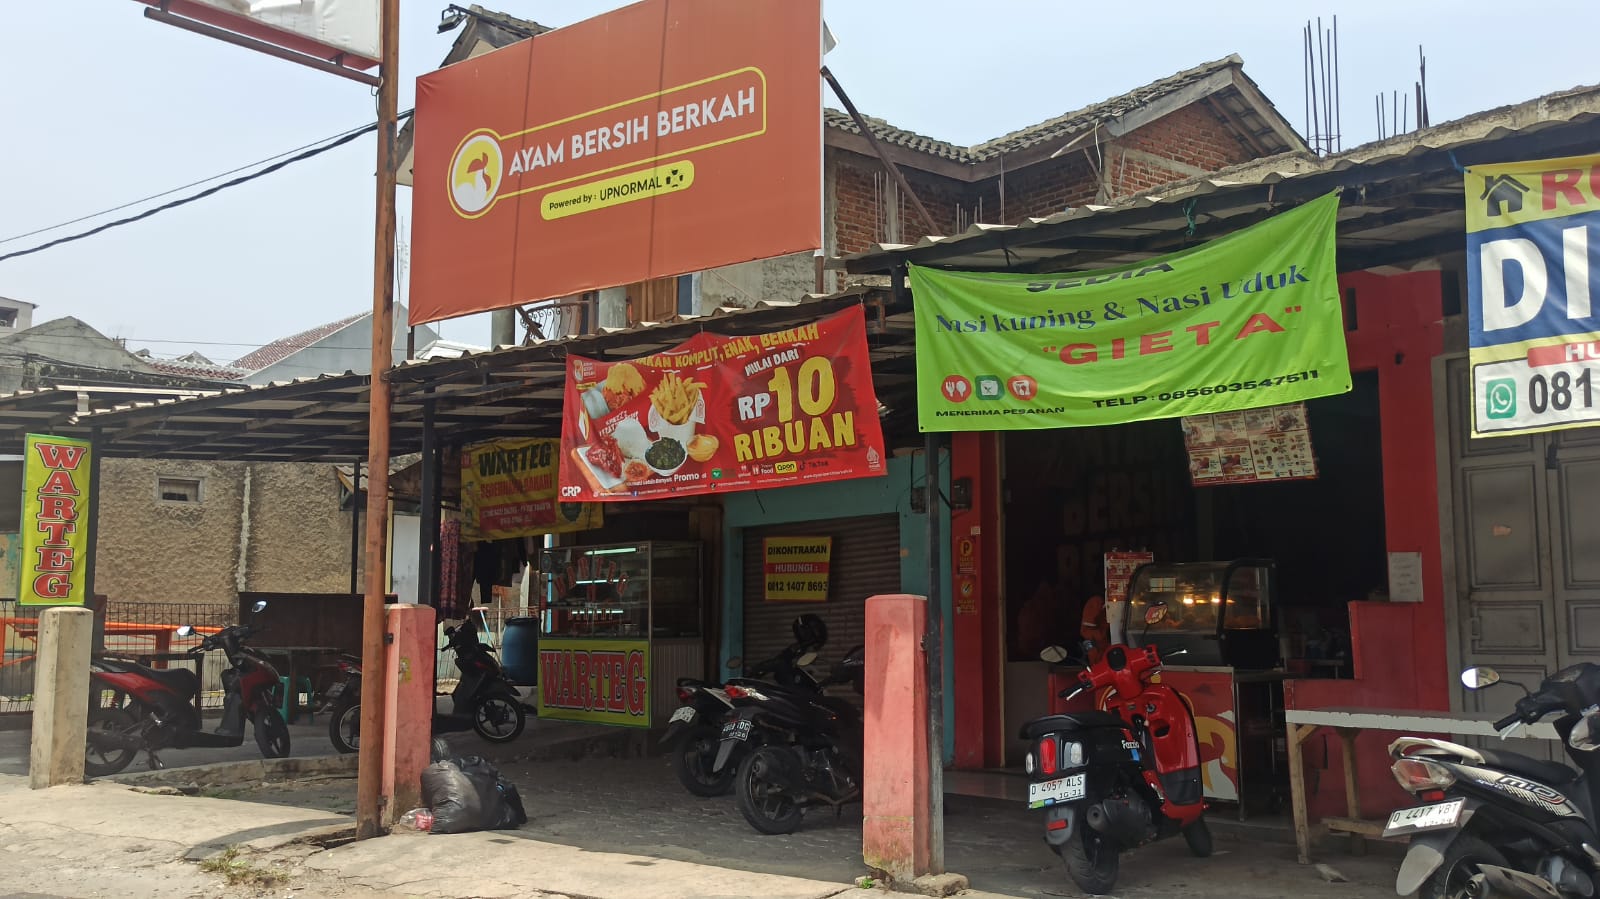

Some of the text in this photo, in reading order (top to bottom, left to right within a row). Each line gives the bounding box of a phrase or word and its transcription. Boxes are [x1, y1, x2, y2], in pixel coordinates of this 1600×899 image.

[508, 86, 756, 177] AYAM BERSIH BERKAH
[549, 194, 582, 211] Powered
[583, 193, 593, 204] by
[599, 175, 663, 202] UPNORMAL
[1540, 166, 1600, 212] R
[1102, 301, 1127, 322] &
[1137, 285, 1212, 316] Nasi
[1220, 263, 1310, 301] Uduk
[744, 348, 800, 377] MULAI DARI
[737, 355, 836, 424] RP 10
[1092, 393, 1148, 409] TELP
[1528, 366, 1593, 415] 081
[935, 406, 1065, 418] MENERIMA PESANAN
[733, 410, 856, 463] RIBUAN
[478, 441, 552, 477] WARTEG
[674, 472, 700, 482] Promo
[32, 442, 87, 599] WARTEG
[767, 545, 827, 555] DIKONTRAKAN
[775, 564, 813, 573] HUBUNGI
[540, 650, 647, 716] WARTEG
[1031, 785, 1037, 795] D
[1066, 776, 1082, 787] ALS
